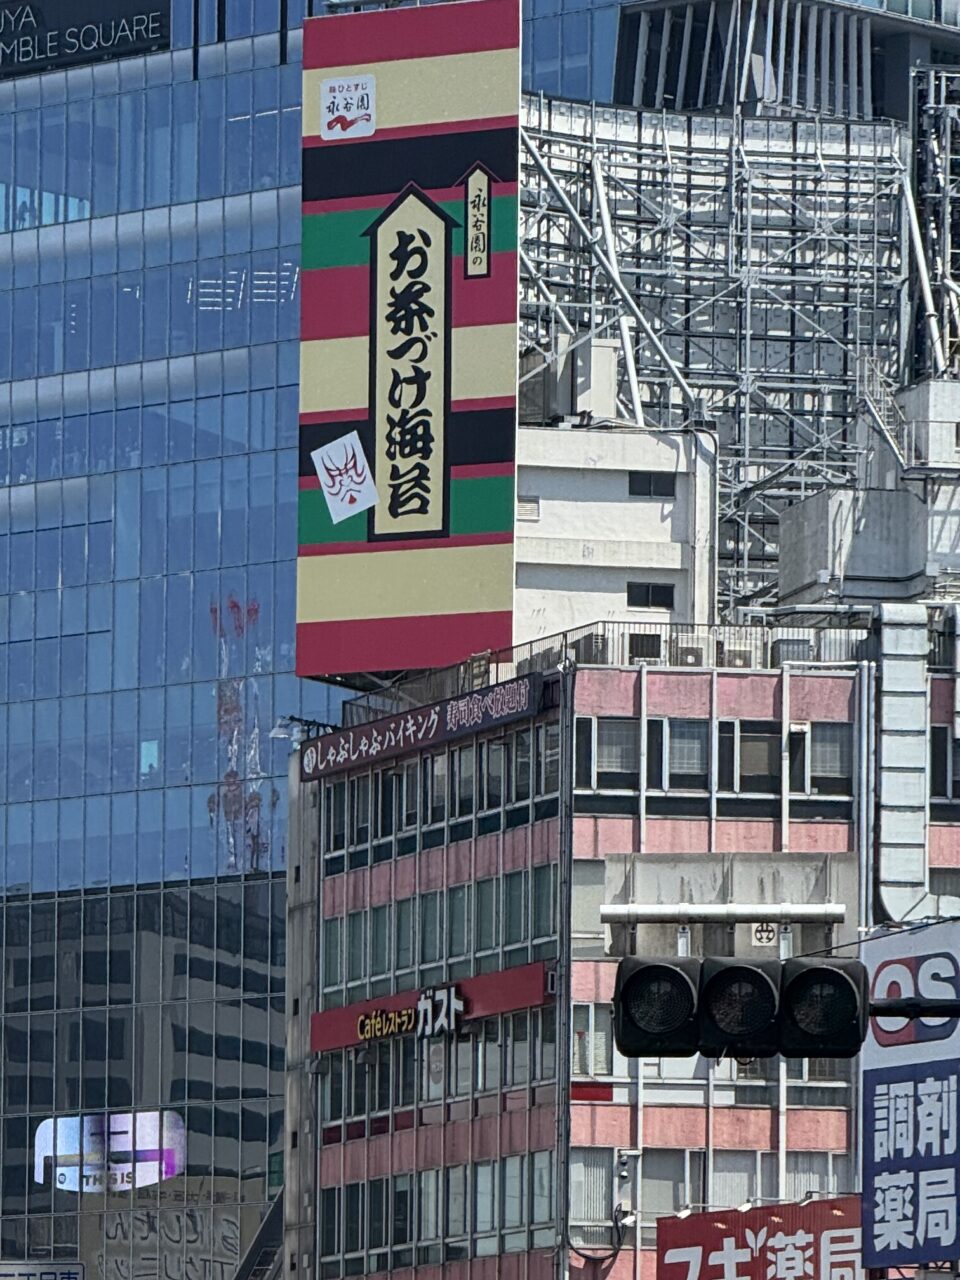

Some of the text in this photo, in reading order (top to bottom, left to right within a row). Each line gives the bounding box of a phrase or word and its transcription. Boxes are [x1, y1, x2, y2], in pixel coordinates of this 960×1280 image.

[64, 12, 161, 54] SQUARE
[325, 93, 370, 116] 永谷園
[469, 188, 487, 266] 永谷園の
[384, 228, 439, 520] お茶づけ海苔
[316, 706, 441, 769] しゃぶしゃぶバイキング
[417, 986, 465, 1039] ガスト
[872, 957, 957, 1033] OS
[872, 1075, 958, 1163] 調剤
[82, 1172, 134, 1187] THS IS
[872, 1168, 958, 1252] 薬局
